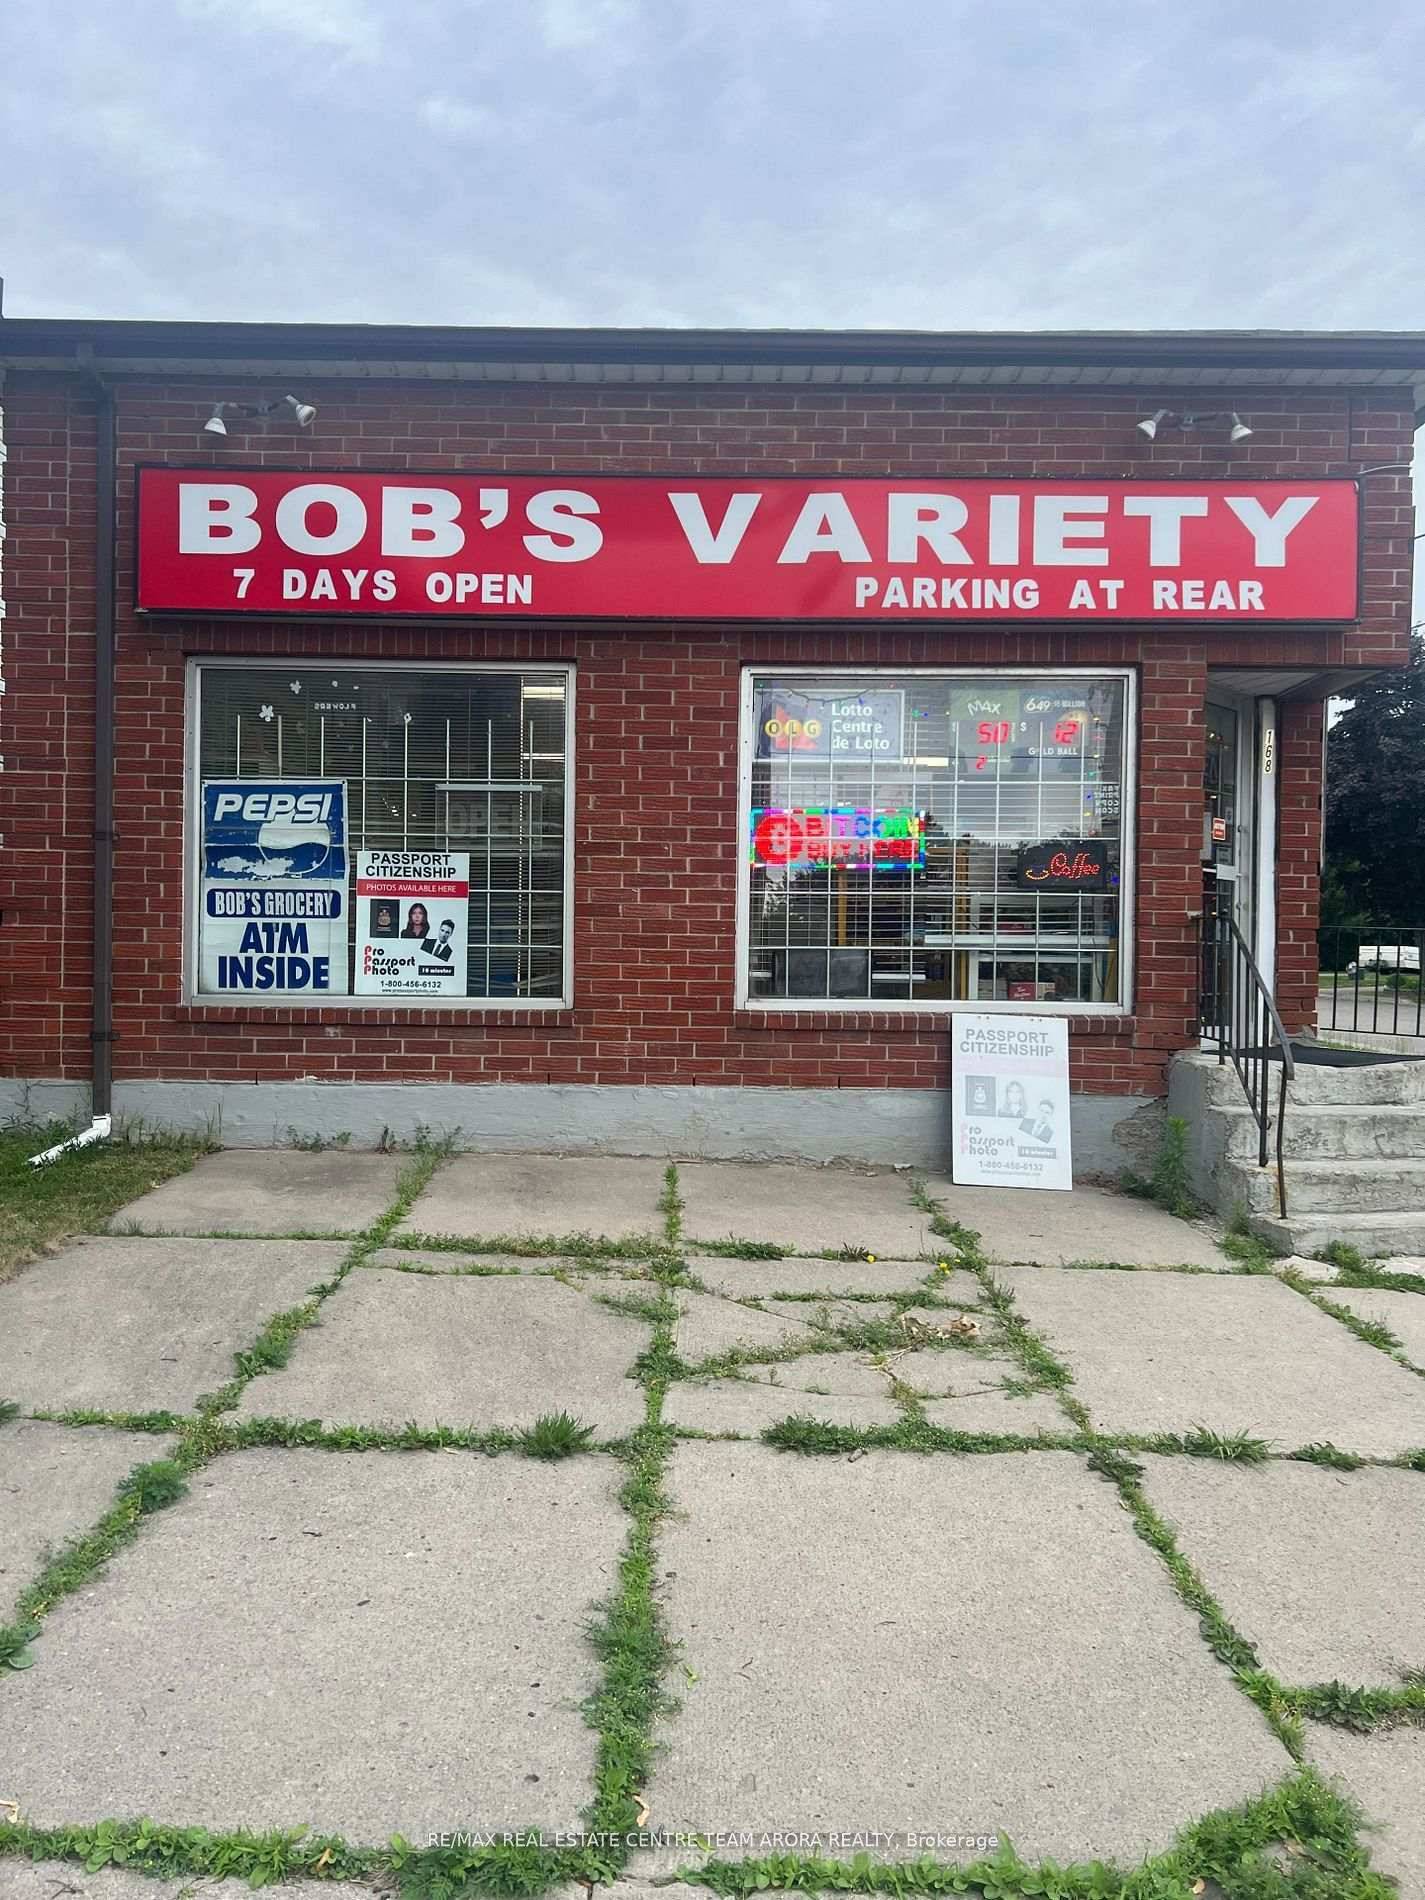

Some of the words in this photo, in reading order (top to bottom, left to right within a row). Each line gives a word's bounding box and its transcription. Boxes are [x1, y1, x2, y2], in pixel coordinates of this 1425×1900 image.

[178, 483, 604, 564] BOB'S
[666, 492, 1320, 568] VARIETY
[232, 569, 256, 599] 7
[283, 569, 398, 602] DAYS
[425, 571, 533, 605] OPEN
[855, 576, 1041, 610] PARKING
[1068, 580, 1126, 610] AT
[1152, 580, 1266, 611] REAR
[831, 703, 873, 717] Lotto
[967, 700, 1001, 716] MAX
[831, 719, 883, 733] Centre
[831, 735, 849, 750] de
[855, 736, 890, 750] Loto
[1057, 747, 1079, 756] BALL
[1264, 730, 1273, 773] 168
[213, 793, 333, 824] PEPSI
[371, 852, 451, 866] PASSPORT
[1050, 852, 1101, 880] Coffee
[365, 865, 457, 879] CITIZENSHIP
[366, 883, 397, 892] PHOTOS
[398, 884, 437, 893] AVAILABLE
[438, 885, 457, 893] HERE
[214, 891, 260, 916] BOB'S
[264, 891, 334, 917] GROCERY
[239, 922, 309, 954] ATM
[364, 945, 385, 956] Pro
[364, 955, 416, 968] Passport
[217, 955, 330, 990] INSIDE
[364, 965, 400, 976] Photo
[380, 980, 442, 988] 1-800-456-6132
[966, 1029, 1049, 1044] PASSPORT
[959, 1041, 1055, 1057] CITIZENSHIP
